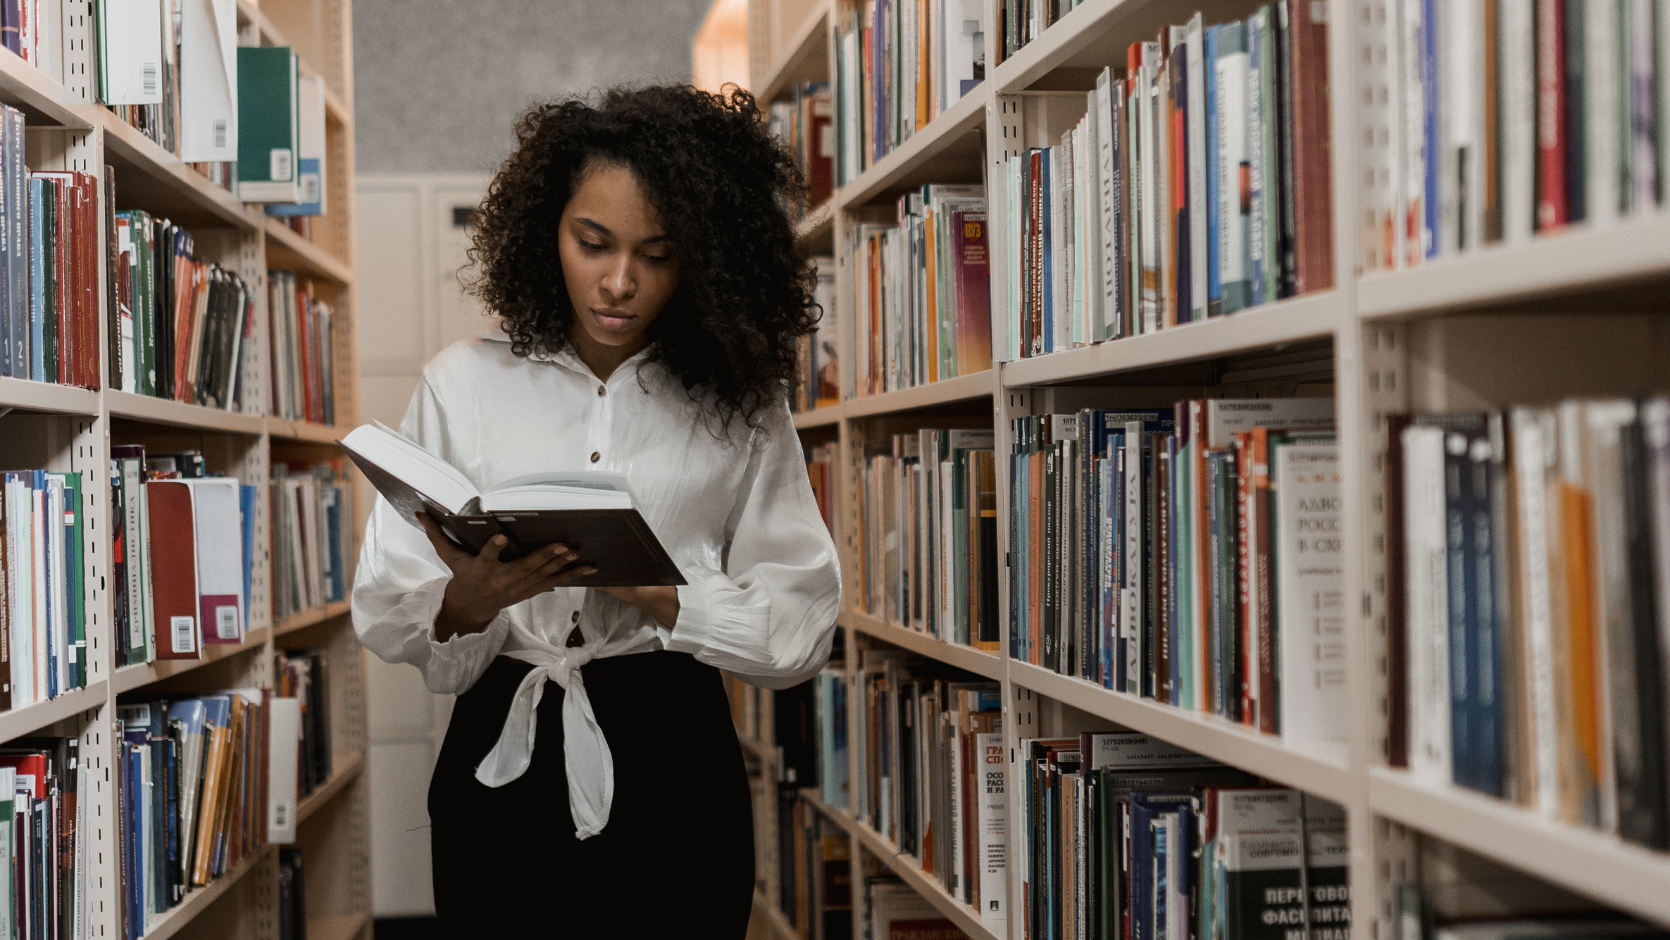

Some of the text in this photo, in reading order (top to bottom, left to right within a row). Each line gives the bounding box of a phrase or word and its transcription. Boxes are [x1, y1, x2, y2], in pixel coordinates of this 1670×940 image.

[964, 223, 982, 238] ВУЗ
[17, 340, 23, 359] 2
[128, 496, 140, 634] КРИМИНАЛИСТИКА
[1129, 474, 1138, 677] АДВОКАТУРА
[1236, 476, 1248, 604] АДВОКАТУРА
